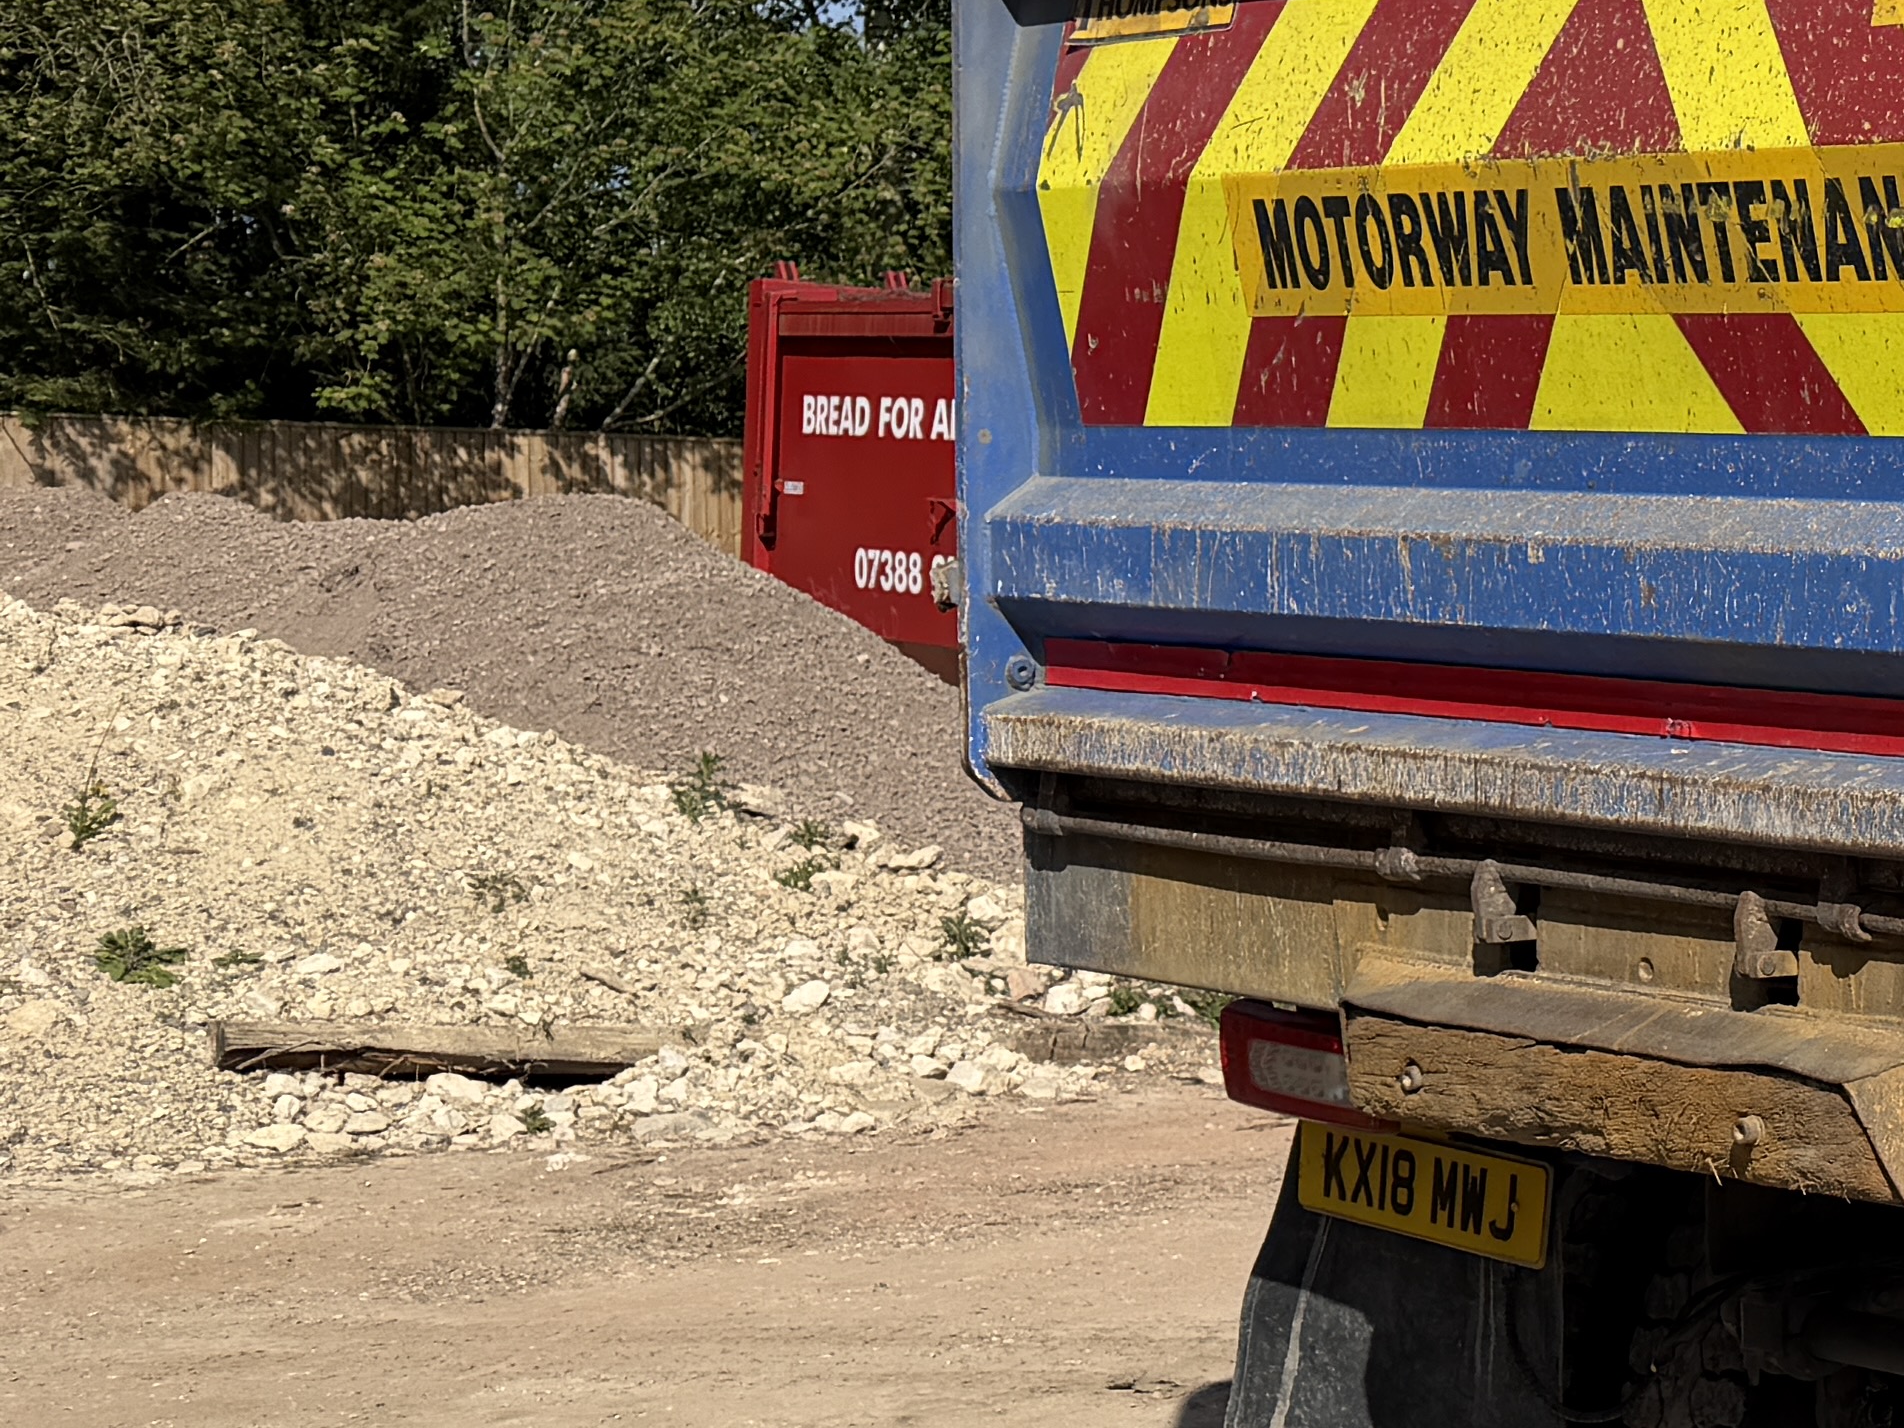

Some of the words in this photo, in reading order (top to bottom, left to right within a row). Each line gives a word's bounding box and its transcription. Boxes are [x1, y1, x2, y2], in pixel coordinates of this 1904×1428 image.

[1252, 187, 1536, 290] MOTORWAY
[802, 394, 871, 437] BREAD
[878, 396, 924, 439] FOR
[855, 547, 922, 594] 07388
[1323, 1132, 1416, 1216] KX18
[1430, 1156, 1518, 1242] MWJ
